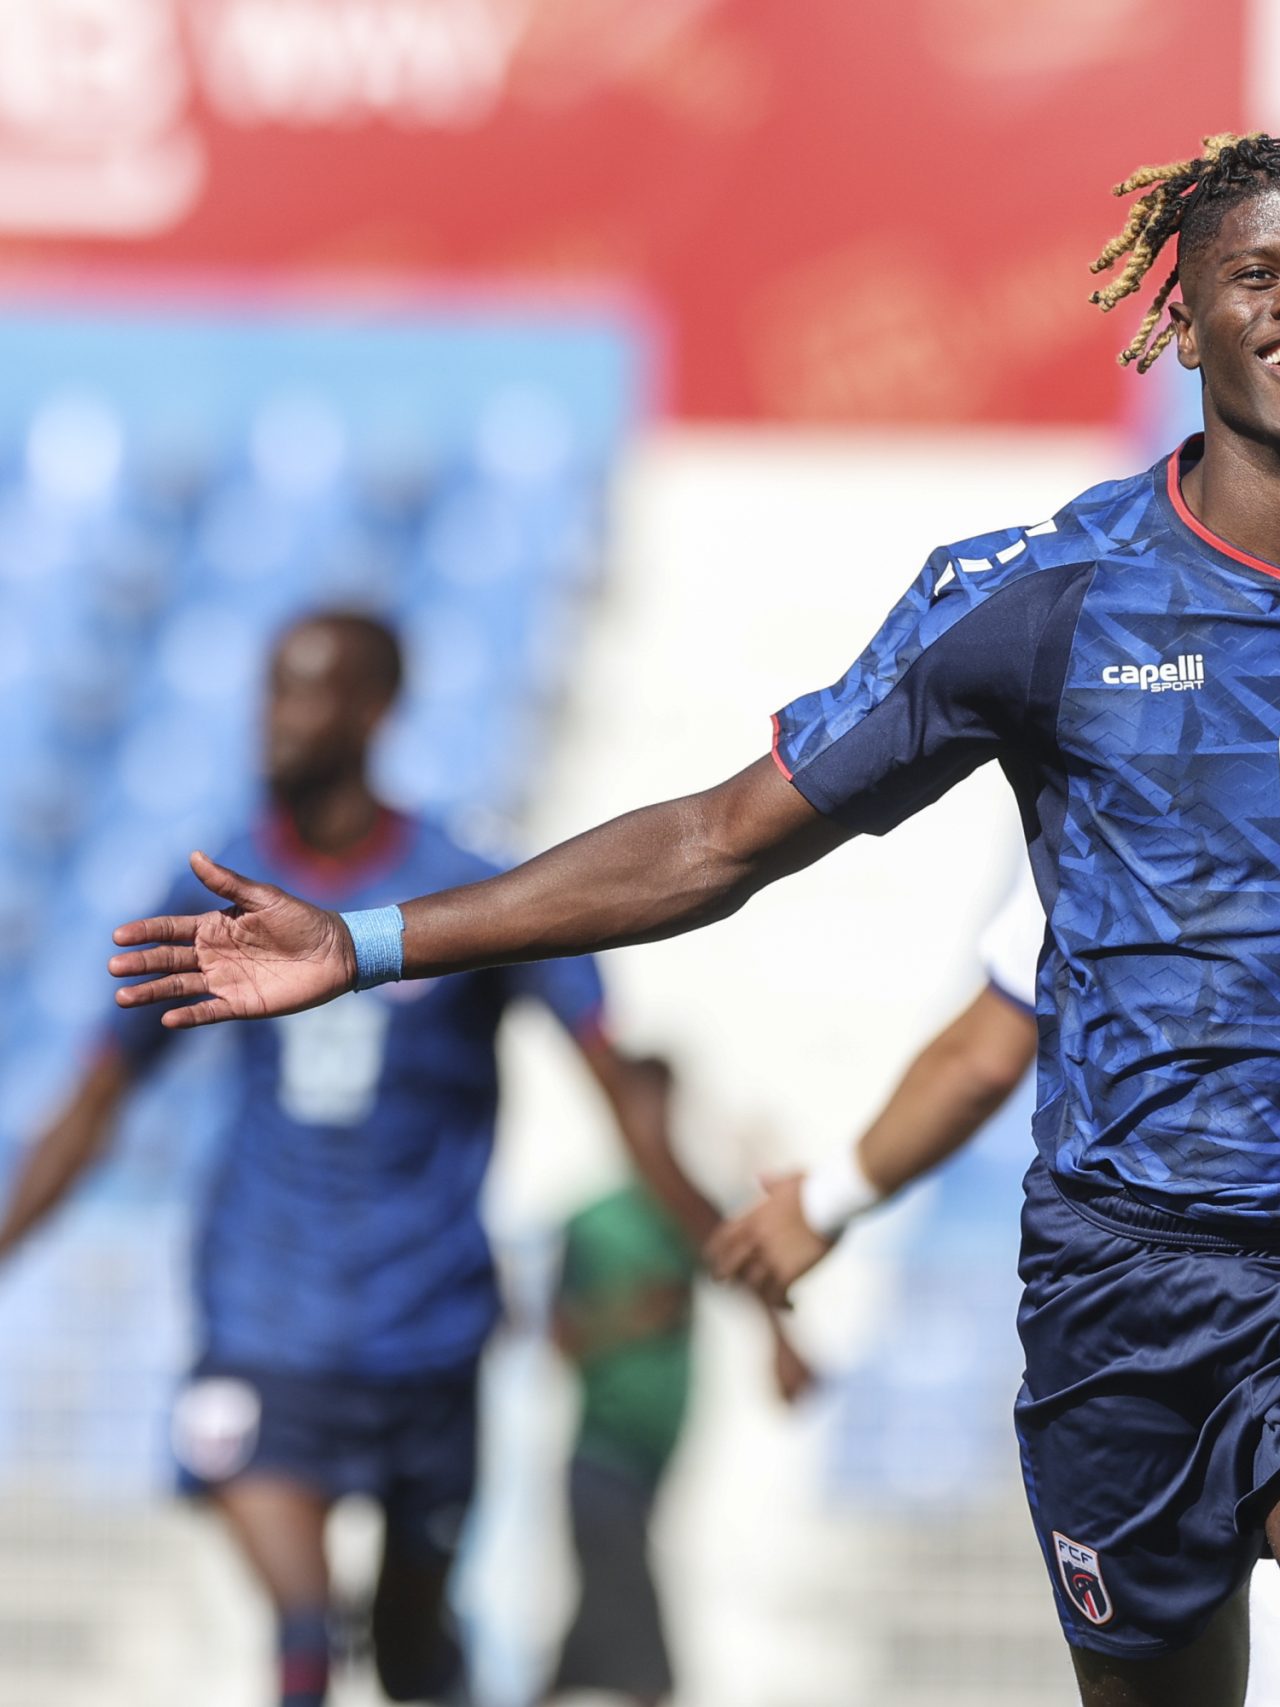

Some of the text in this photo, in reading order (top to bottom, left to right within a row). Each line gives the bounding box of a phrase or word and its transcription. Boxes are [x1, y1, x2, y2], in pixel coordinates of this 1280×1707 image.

[1102, 654, 1204, 690] capelli
[1150, 680, 1205, 693] SPORT
[1058, 1539, 1093, 1564] FCF
